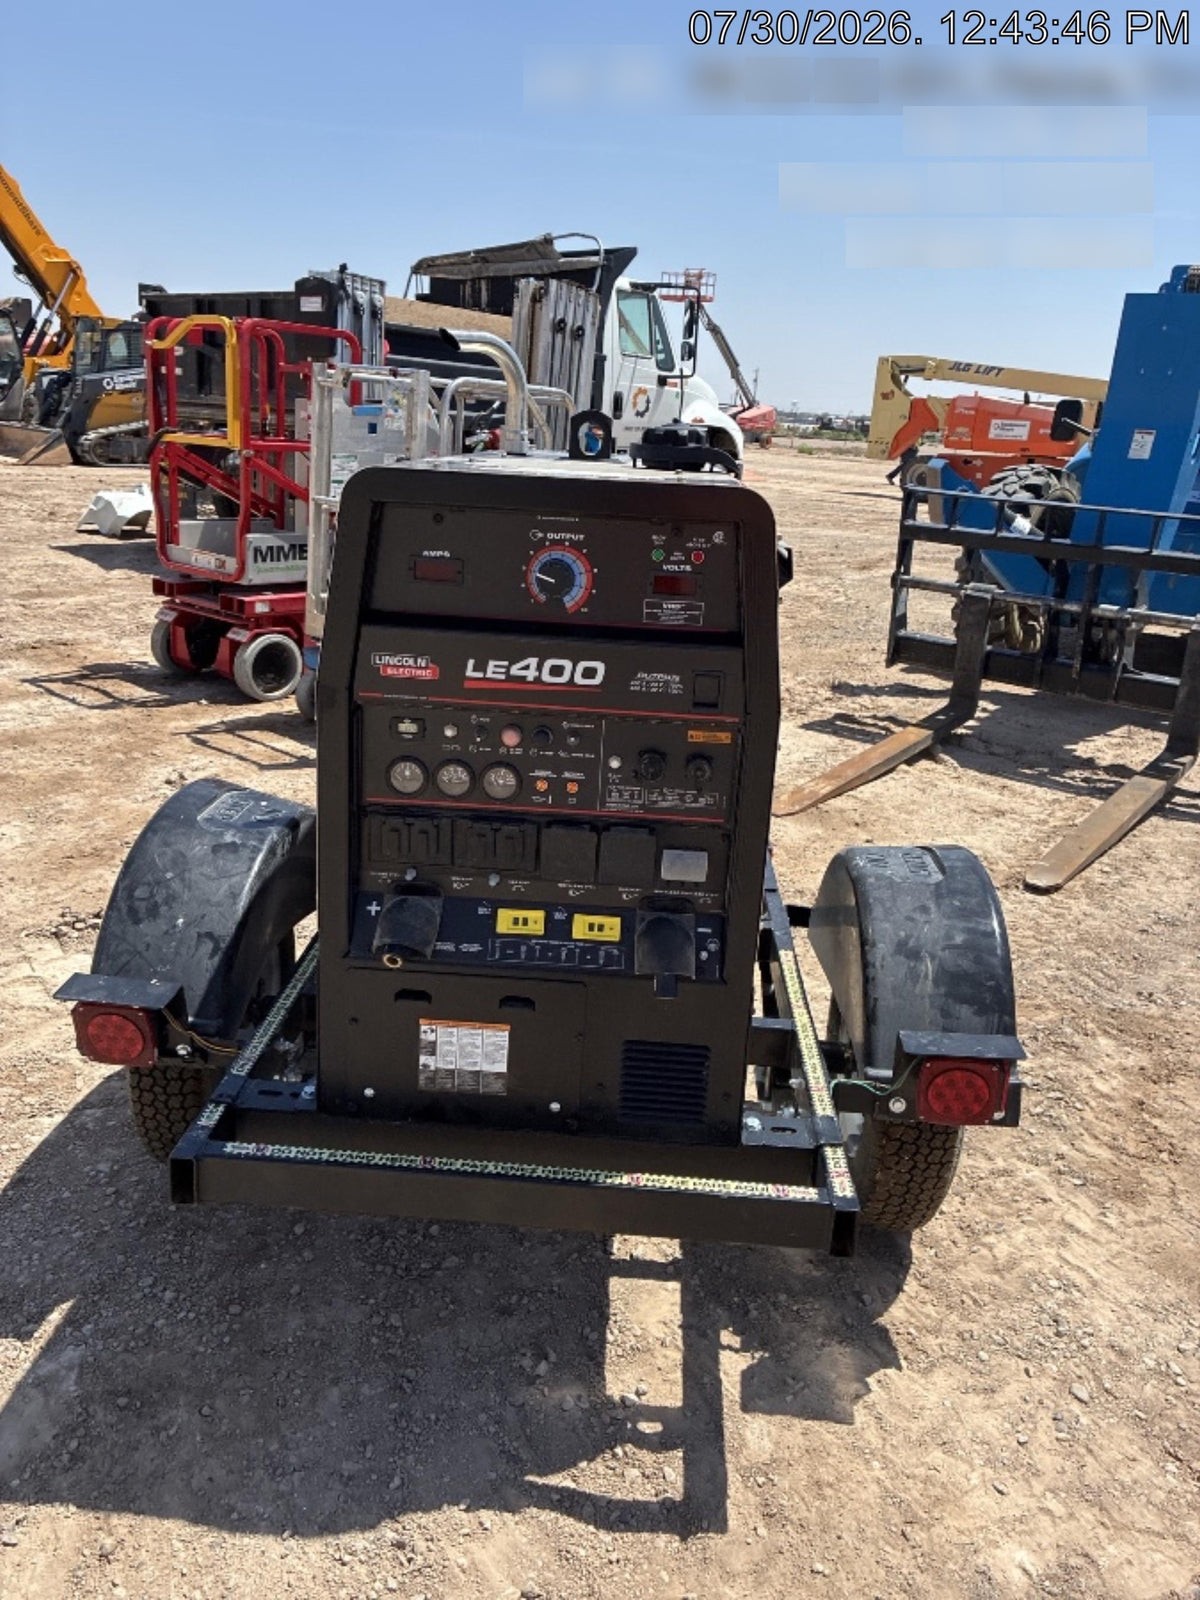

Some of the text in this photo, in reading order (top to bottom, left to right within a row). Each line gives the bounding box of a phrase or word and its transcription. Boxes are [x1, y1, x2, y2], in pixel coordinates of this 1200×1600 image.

[948, 361, 1005, 378] JLG LIFT
[546, 532, 586, 541] OUTPUT
[662, 564, 693, 572] VOLTS
[375, 655, 428, 668] LINCOLN
[386, 667, 434, 678] ELECTRIC
[465, 657, 606, 686] LE400
[271, 1146, 292, 1157] DO
[294, 1149, 327, 1160] NOT
